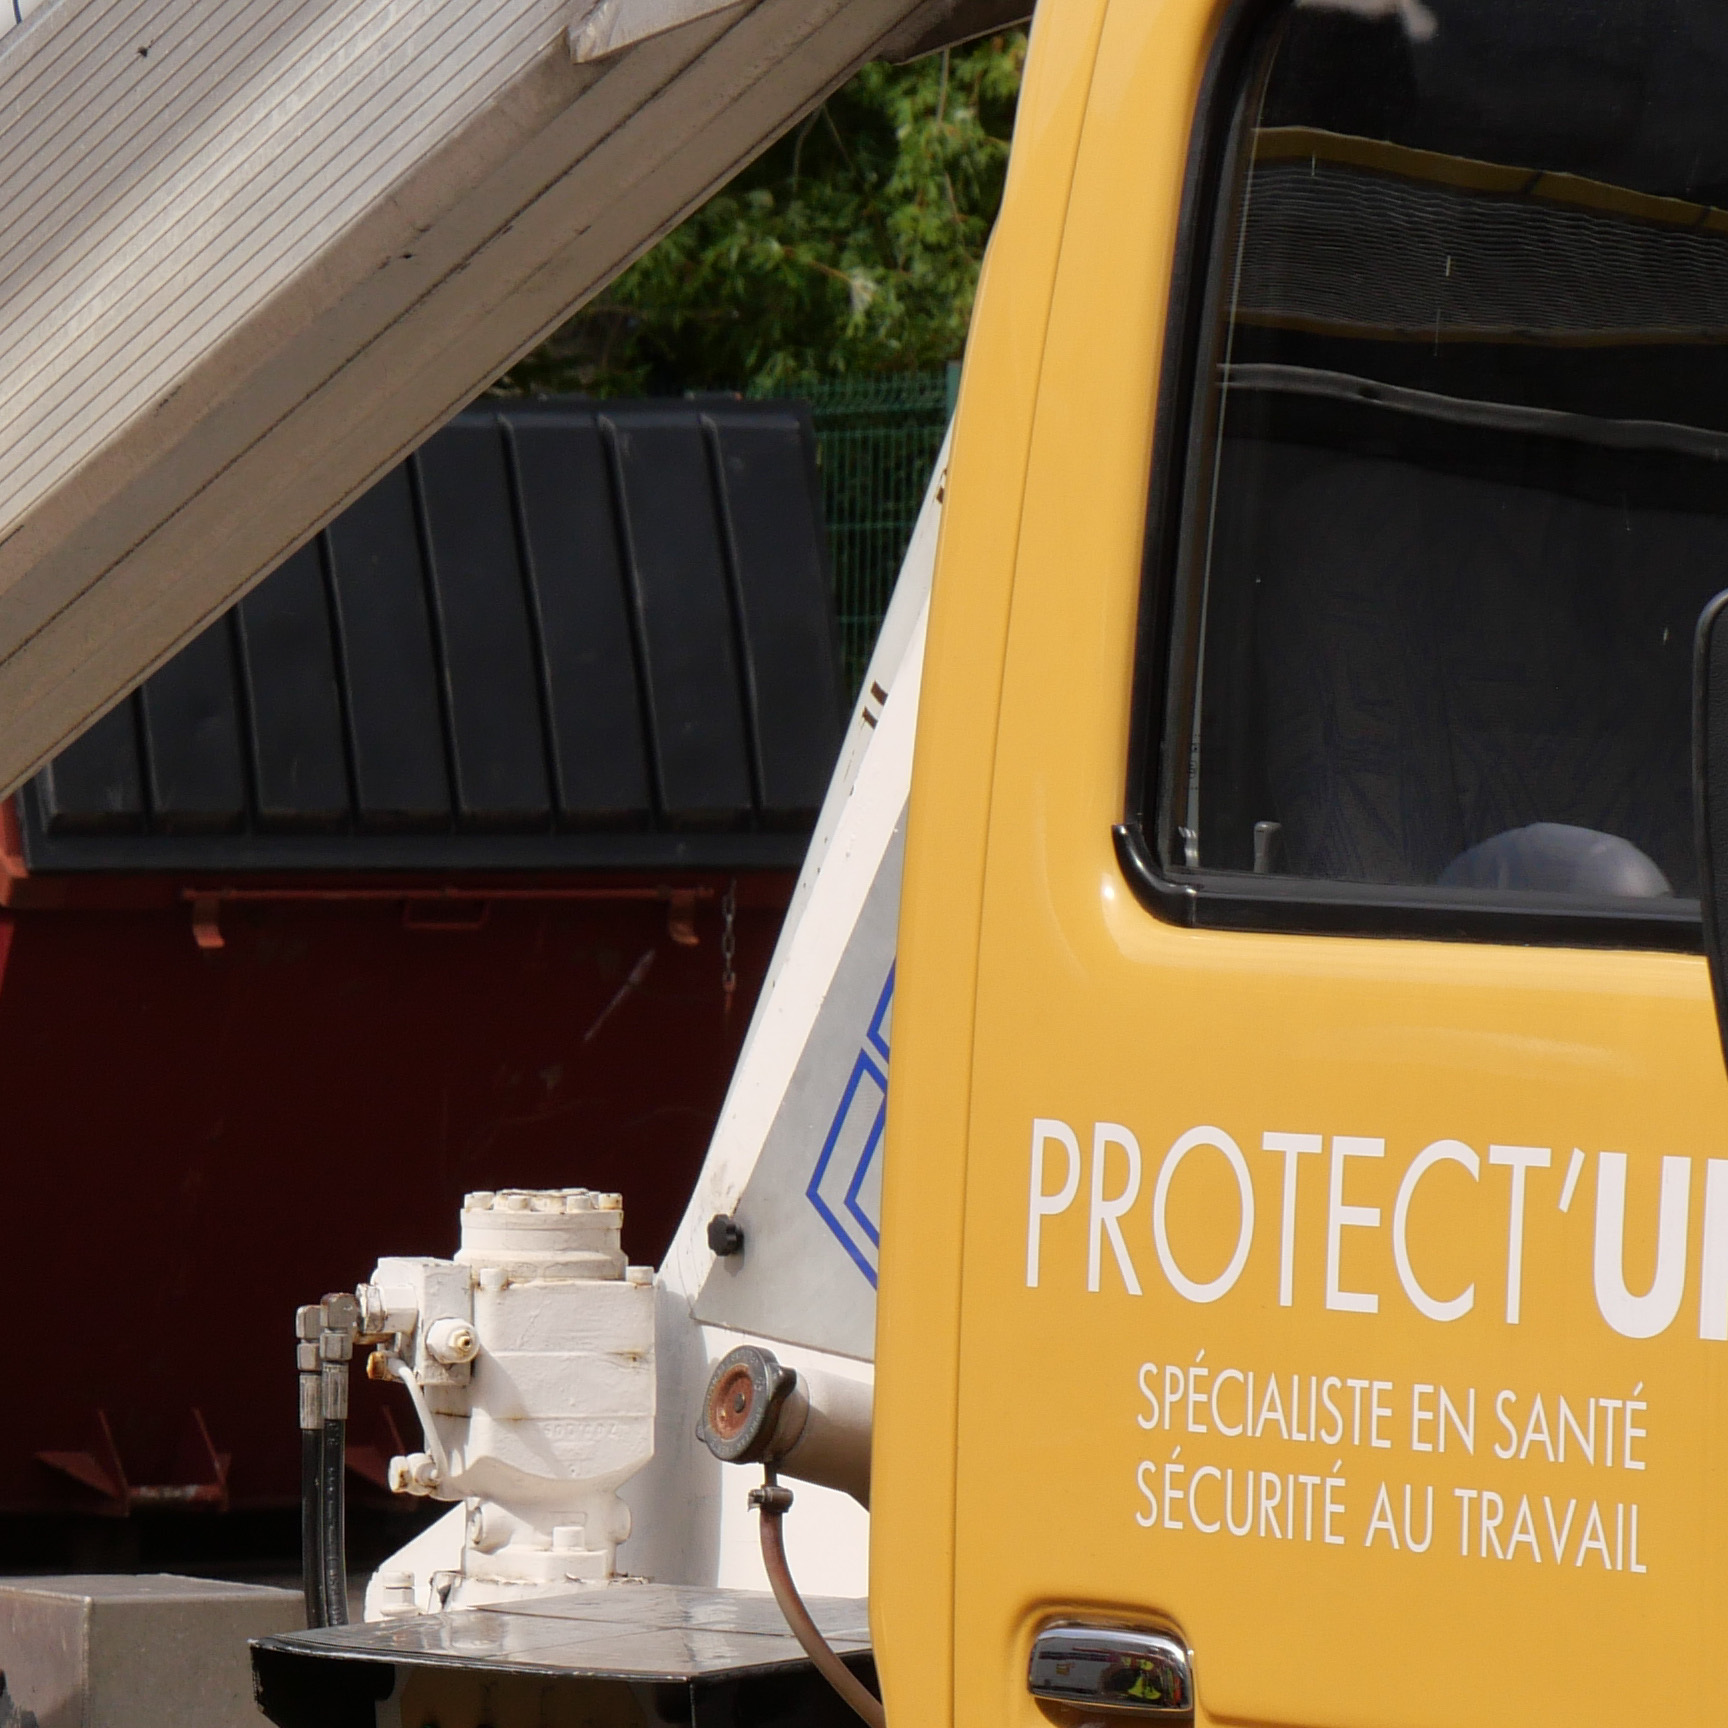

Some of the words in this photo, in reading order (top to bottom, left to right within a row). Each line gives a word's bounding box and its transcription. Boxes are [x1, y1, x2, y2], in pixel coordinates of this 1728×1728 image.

[1137, 1348, 1393, 1449] SPÉCIALISTE
[1411, 1384, 1475, 1455] EN
[1494, 1381, 1648, 1471] SANTÉ
[1135, 1446, 1345, 1545] SÉCURITÉ
[1364, 1482, 1434, 1553] AU
[1454, 1488, 1648, 1574] TRAVAIL
